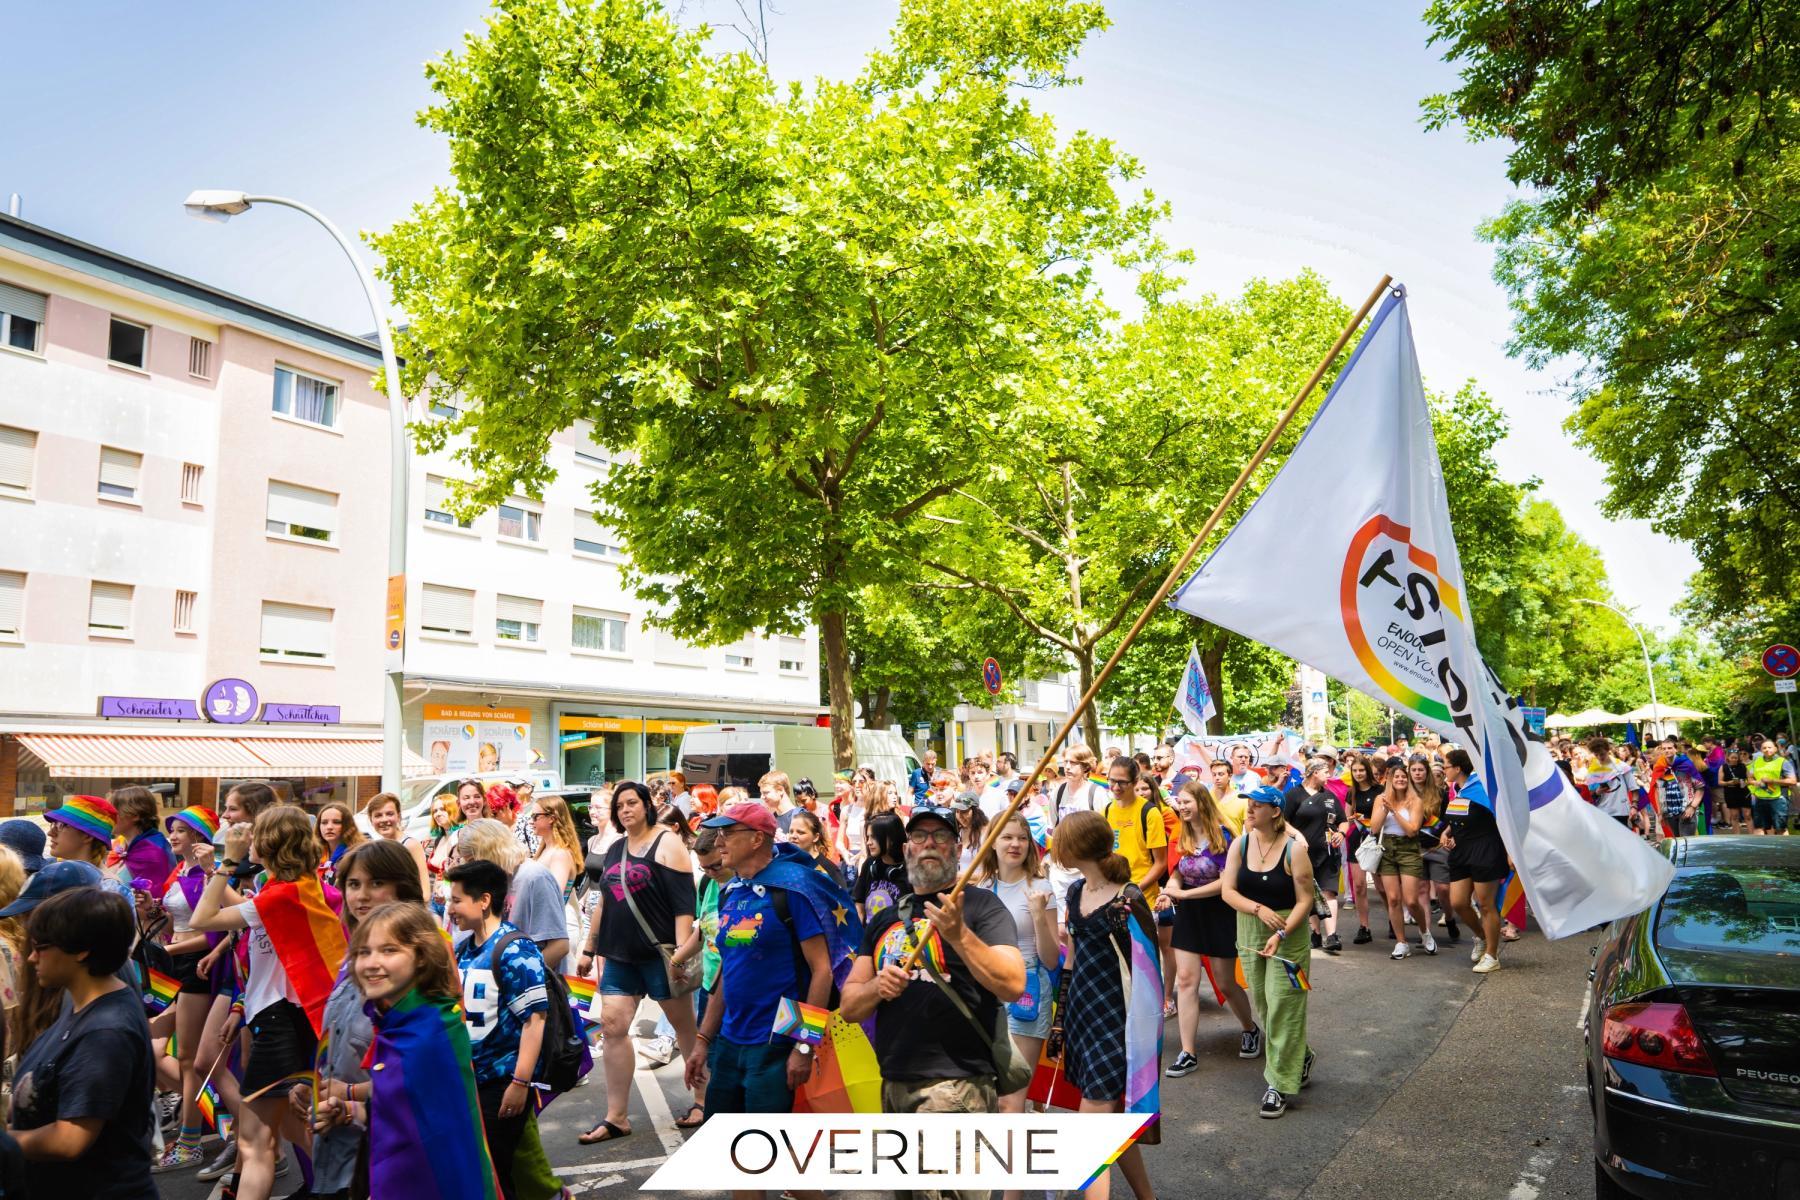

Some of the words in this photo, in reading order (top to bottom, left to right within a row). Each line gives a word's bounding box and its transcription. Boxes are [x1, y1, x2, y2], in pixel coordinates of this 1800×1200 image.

[1377, 636, 1414, 661] OPEN
[116, 700, 182, 716] Schneider's
[276, 707, 331, 722] Schnittchen
[440, 709, 453, 717] BAD
